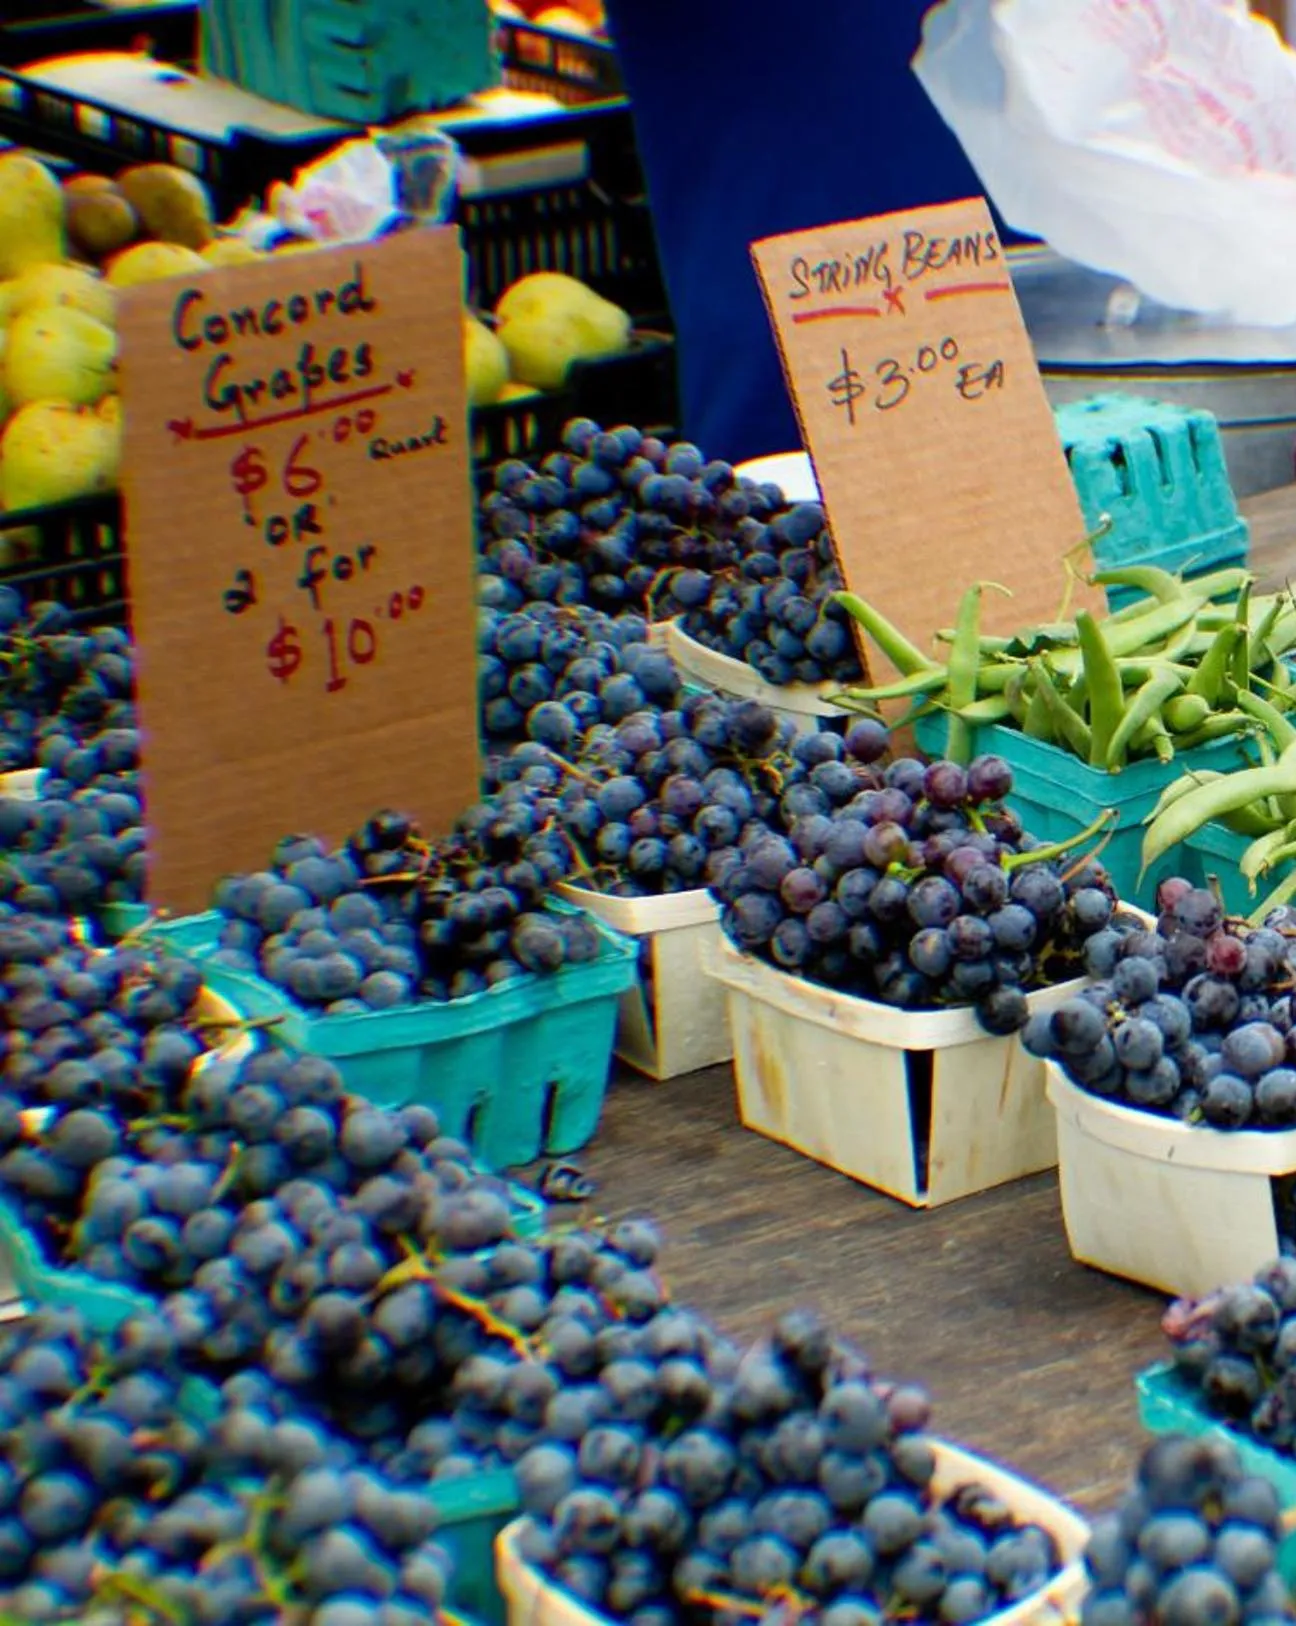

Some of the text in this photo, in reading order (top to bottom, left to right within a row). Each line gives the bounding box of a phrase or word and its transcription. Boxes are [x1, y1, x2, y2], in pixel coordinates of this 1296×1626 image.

[902, 231, 998, 281] BEANS
[172, 261, 375, 349] Concord
[203, 343, 373, 423] Grapes
[827, 337, 1003, 425] $3.00 EA
[369, 415, 447, 459] Quart
[222, 545, 375, 613] 2 for
